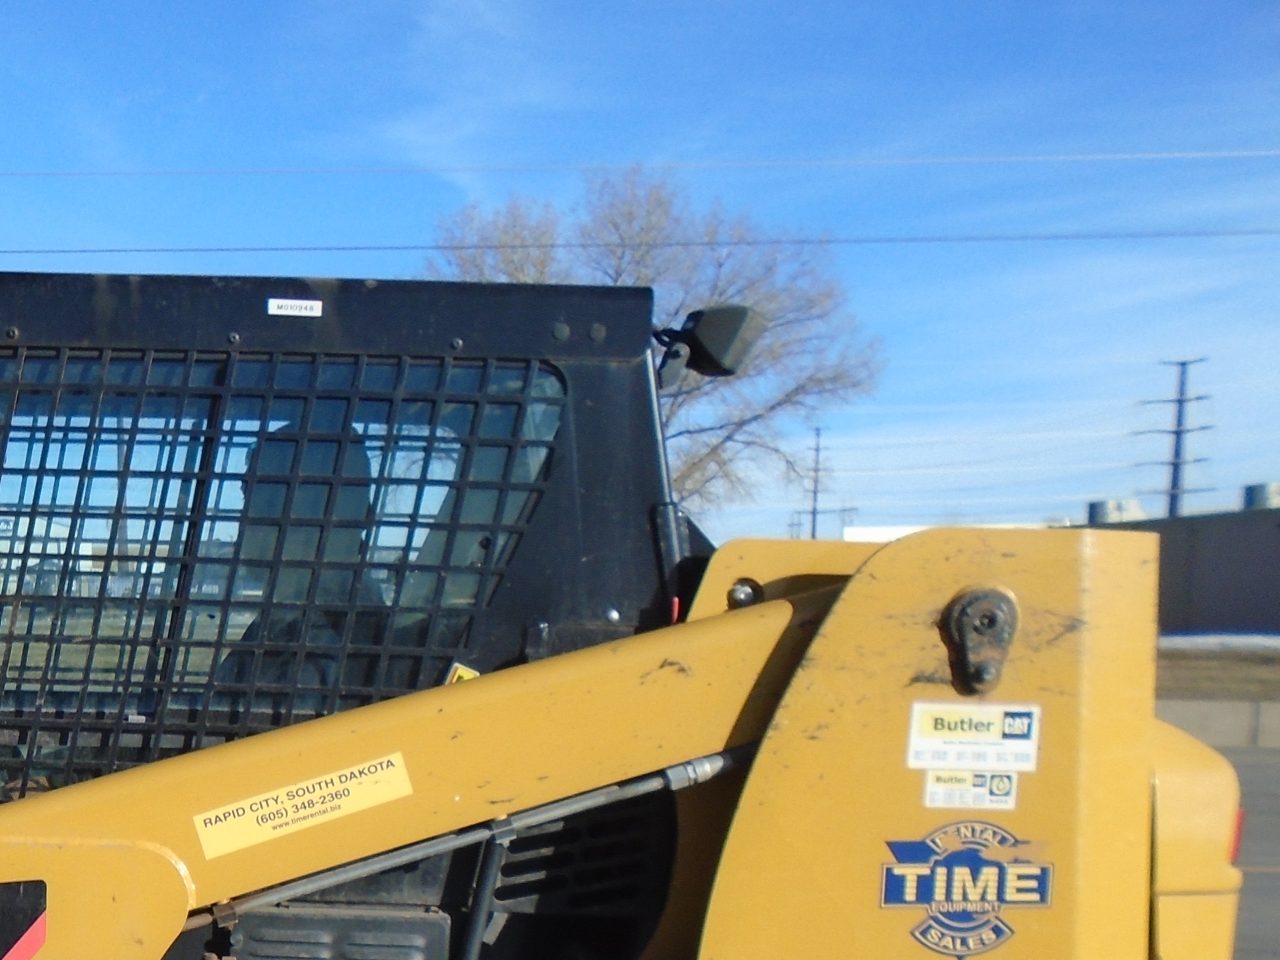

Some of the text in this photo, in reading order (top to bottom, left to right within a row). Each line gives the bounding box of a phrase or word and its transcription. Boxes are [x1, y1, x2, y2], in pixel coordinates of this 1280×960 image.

[933, 717, 994, 732] Butler
[935, 776, 967, 784] Butler
[204, 759, 396, 828] RAPID CITY, SOUTH DAKOTA
[255, 787, 351, 826] (605) 348-2360
[271, 804, 342, 831] www.timerental.biz
[934, 824, 1004, 849] NTAL
[892, 866, 1041, 901] TIME
[931, 901, 1000, 913] EQUIPMENT
[926, 927, 998, 951] SALES
